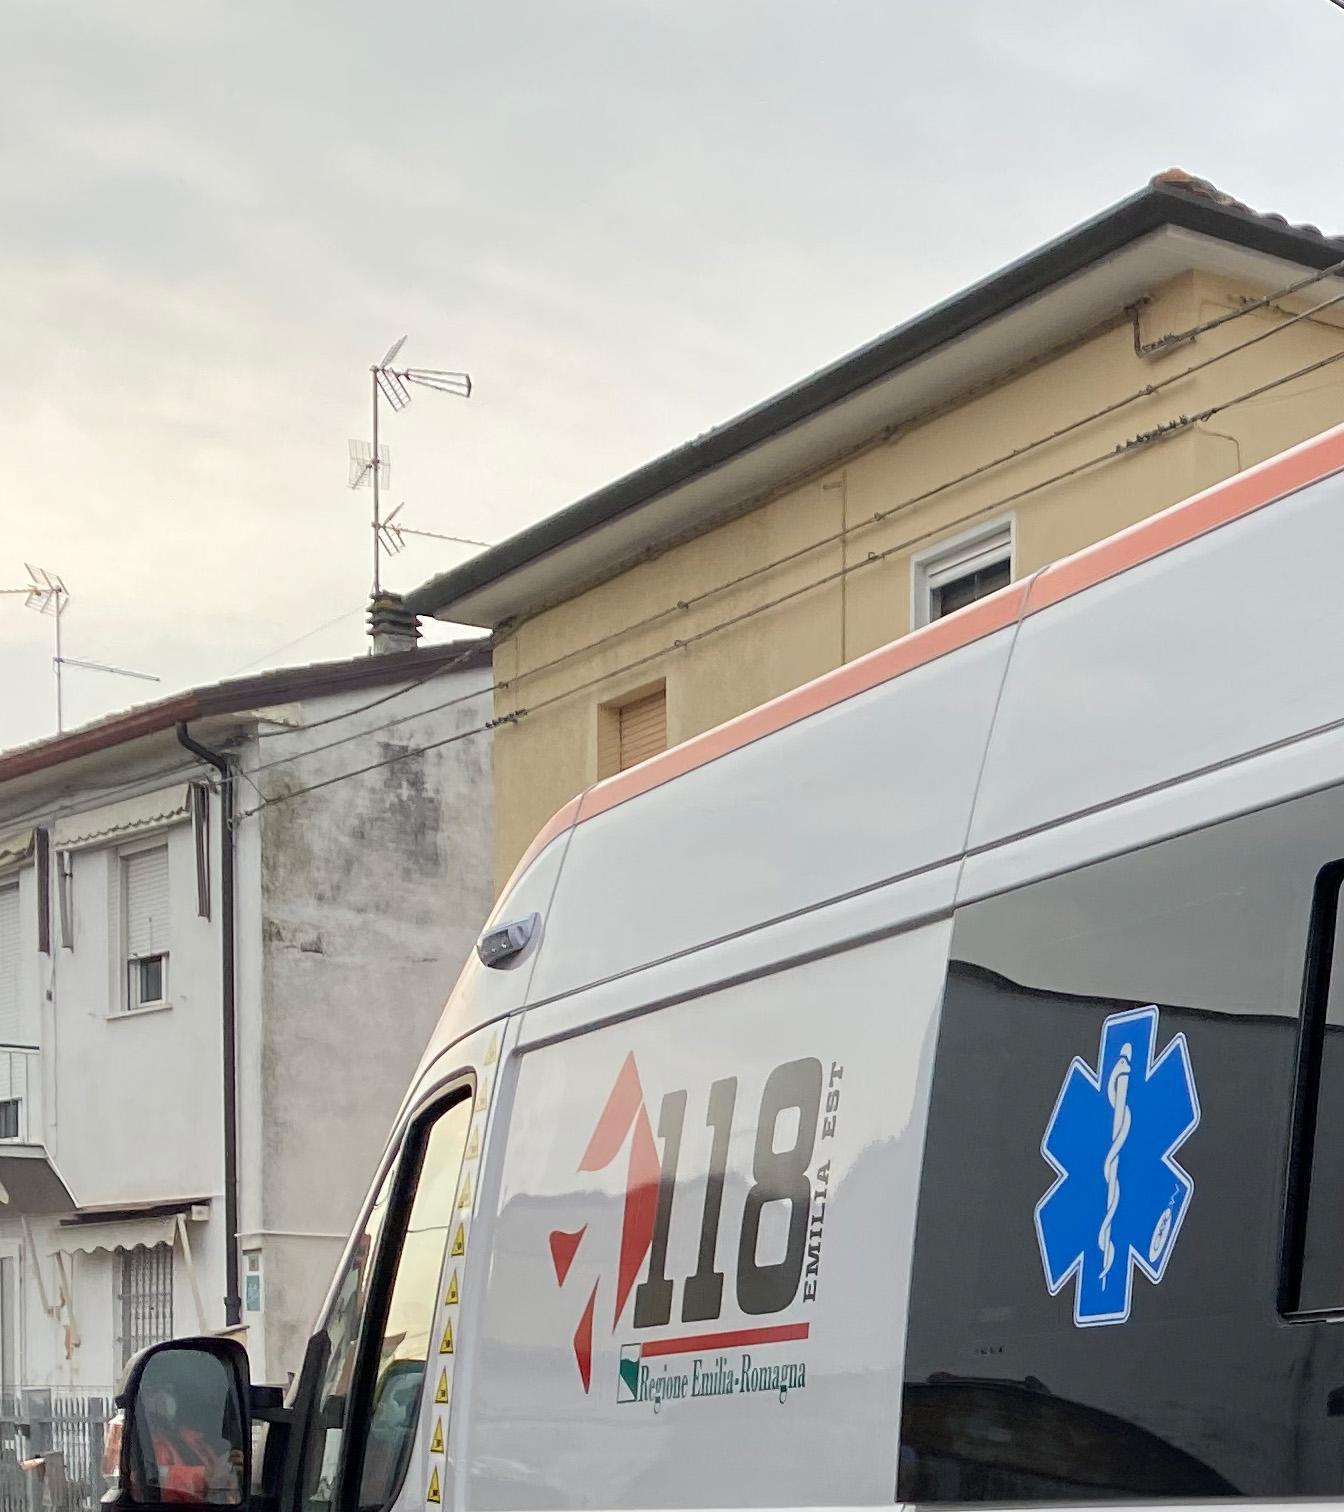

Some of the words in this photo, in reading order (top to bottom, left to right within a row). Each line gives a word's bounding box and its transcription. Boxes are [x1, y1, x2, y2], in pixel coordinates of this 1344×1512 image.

[633, 1056, 823, 1329] 118
[803, 1160, 832, 1303] EMILIA
[822, 1061, 845, 1140] EST
[639, 1363, 689, 1415] Regione
[690, 1353, 807, 1405] Emilia-Romagna
